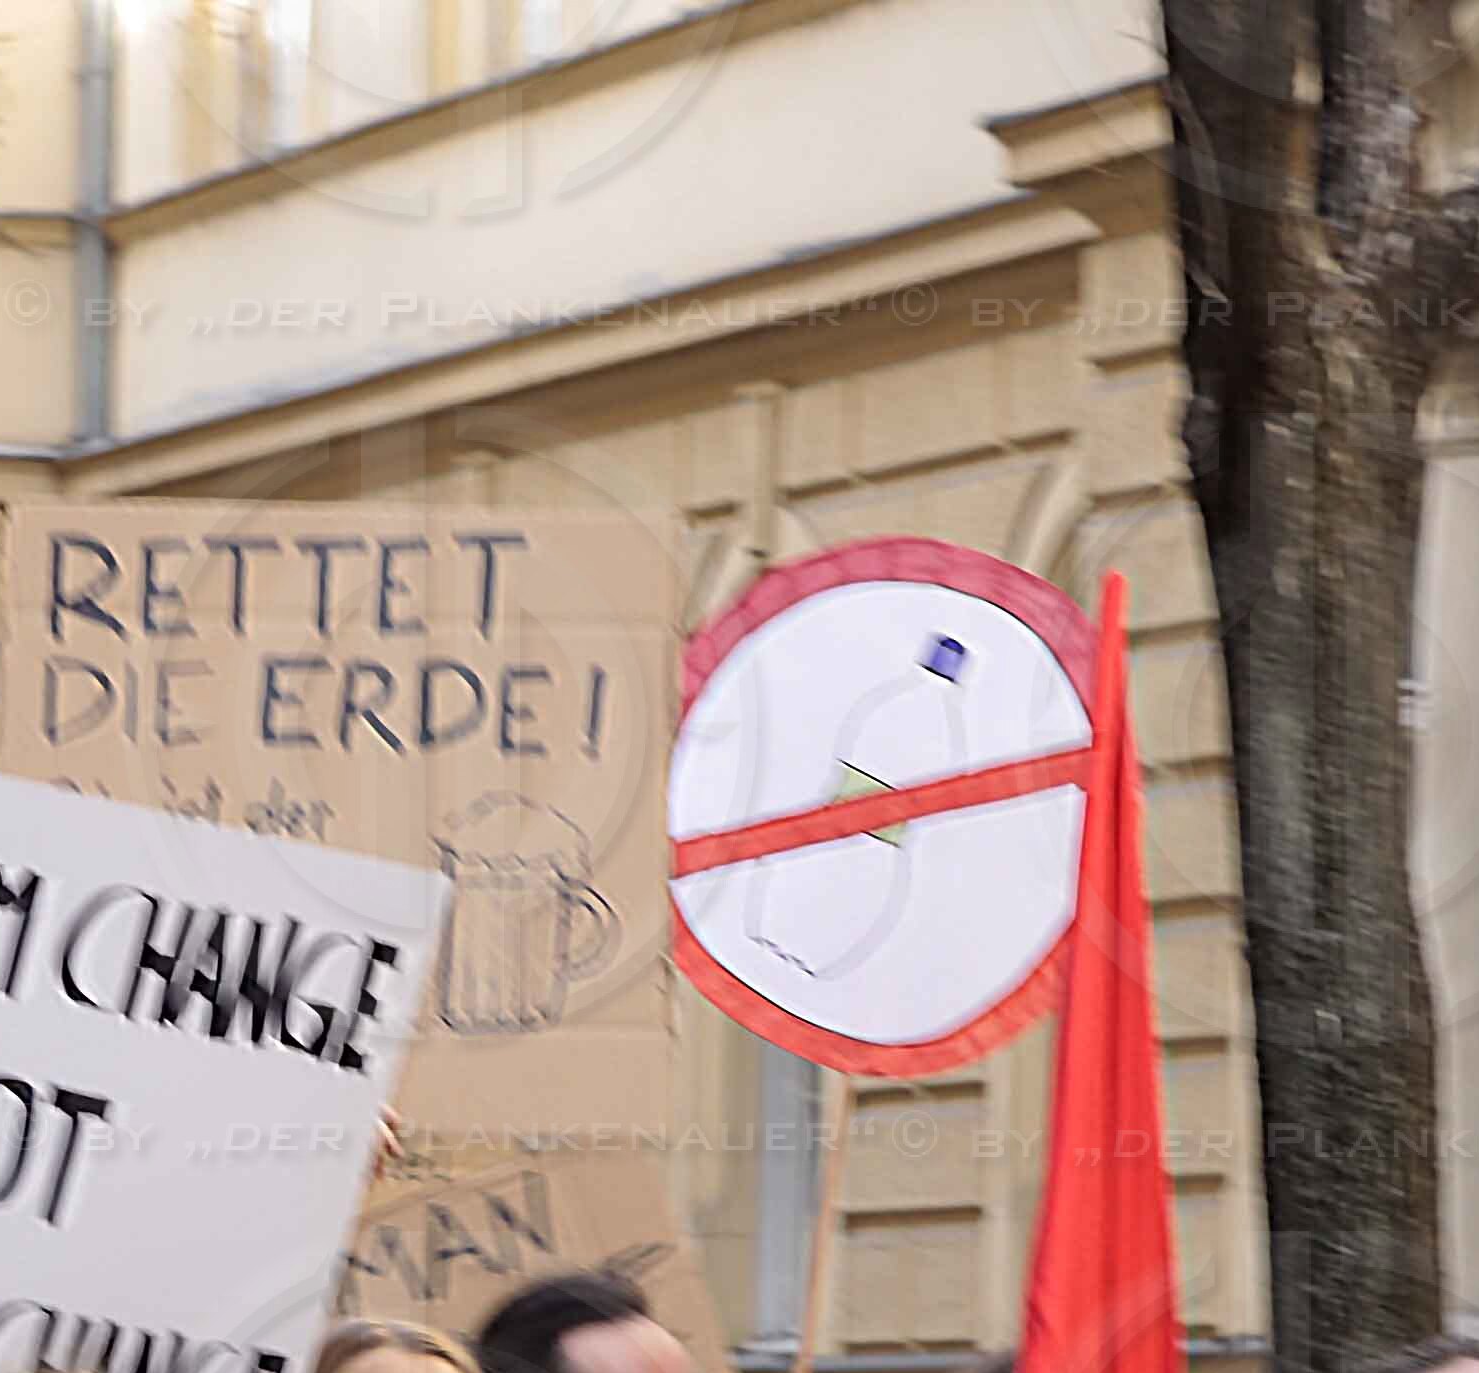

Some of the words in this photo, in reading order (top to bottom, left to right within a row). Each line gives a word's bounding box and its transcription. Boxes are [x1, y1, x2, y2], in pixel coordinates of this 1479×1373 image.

[48, 532, 530, 640] RETTET
[42, 655, 213, 748] DIE
[259, 655, 608, 760] ERDE!
[60, 882, 402, 1075] CHANGE
